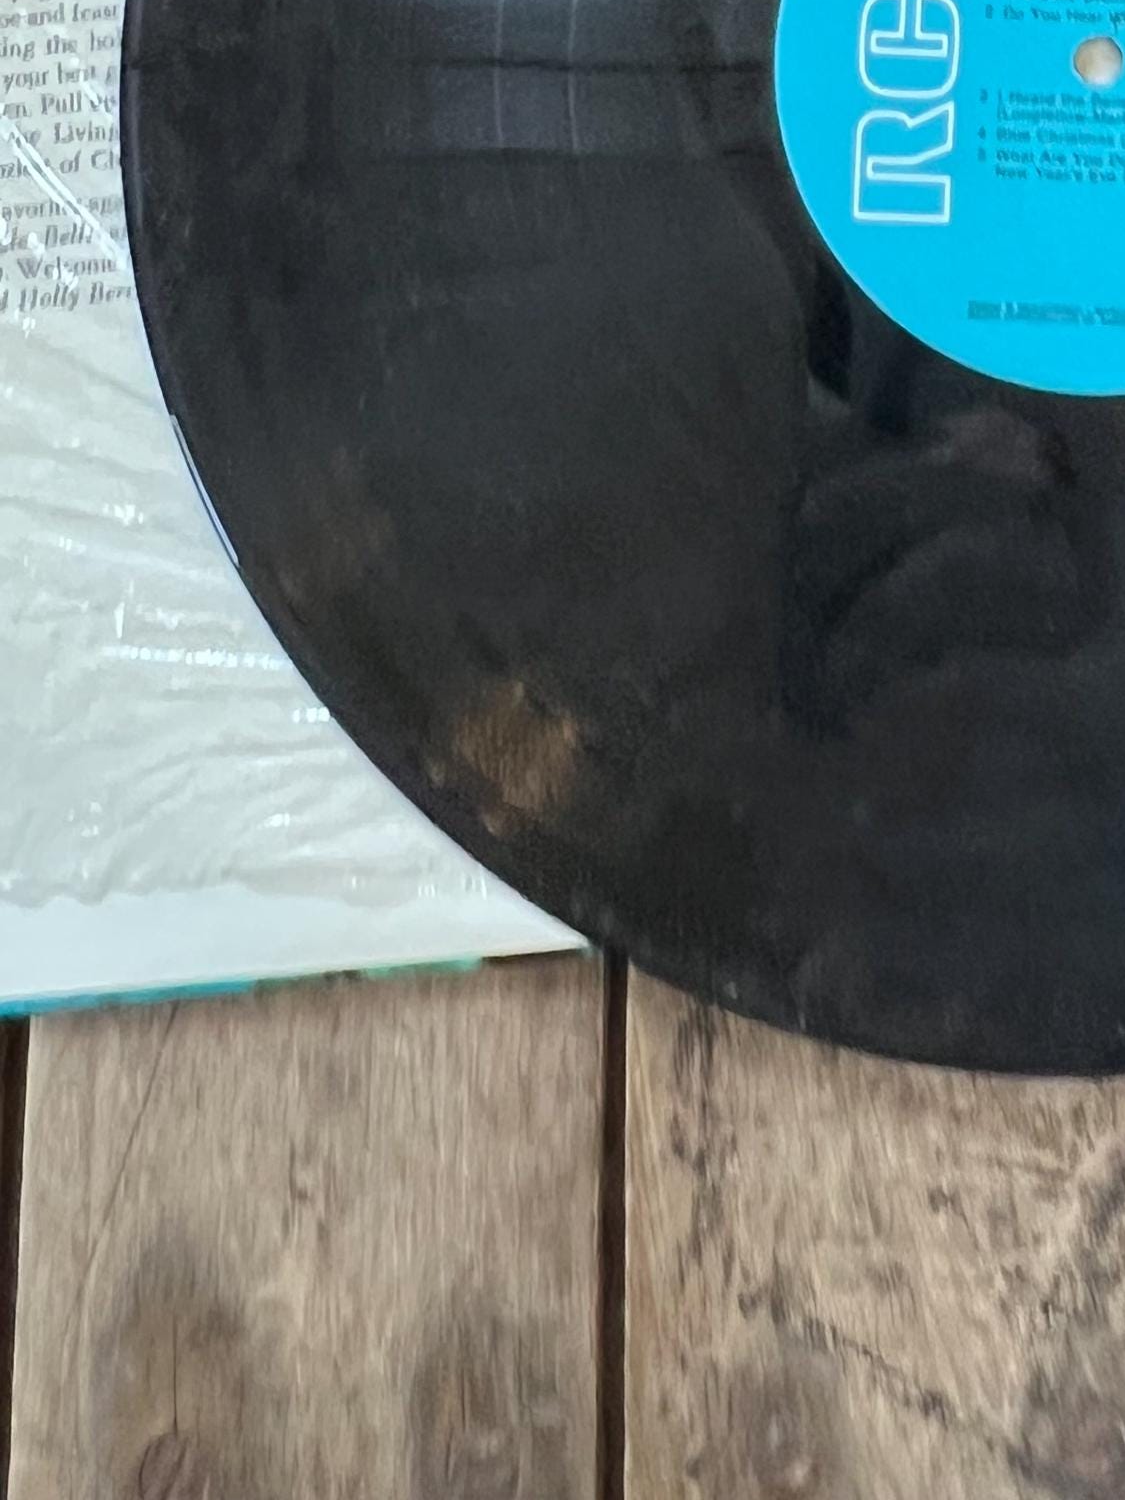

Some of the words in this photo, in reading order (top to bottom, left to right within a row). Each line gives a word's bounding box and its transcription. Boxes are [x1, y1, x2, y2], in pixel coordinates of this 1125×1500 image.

[46, 34, 78, 55] the
[4, 69, 49, 95] your
[41, 90, 83, 115] Pull
[59, 150, 82, 174] of
